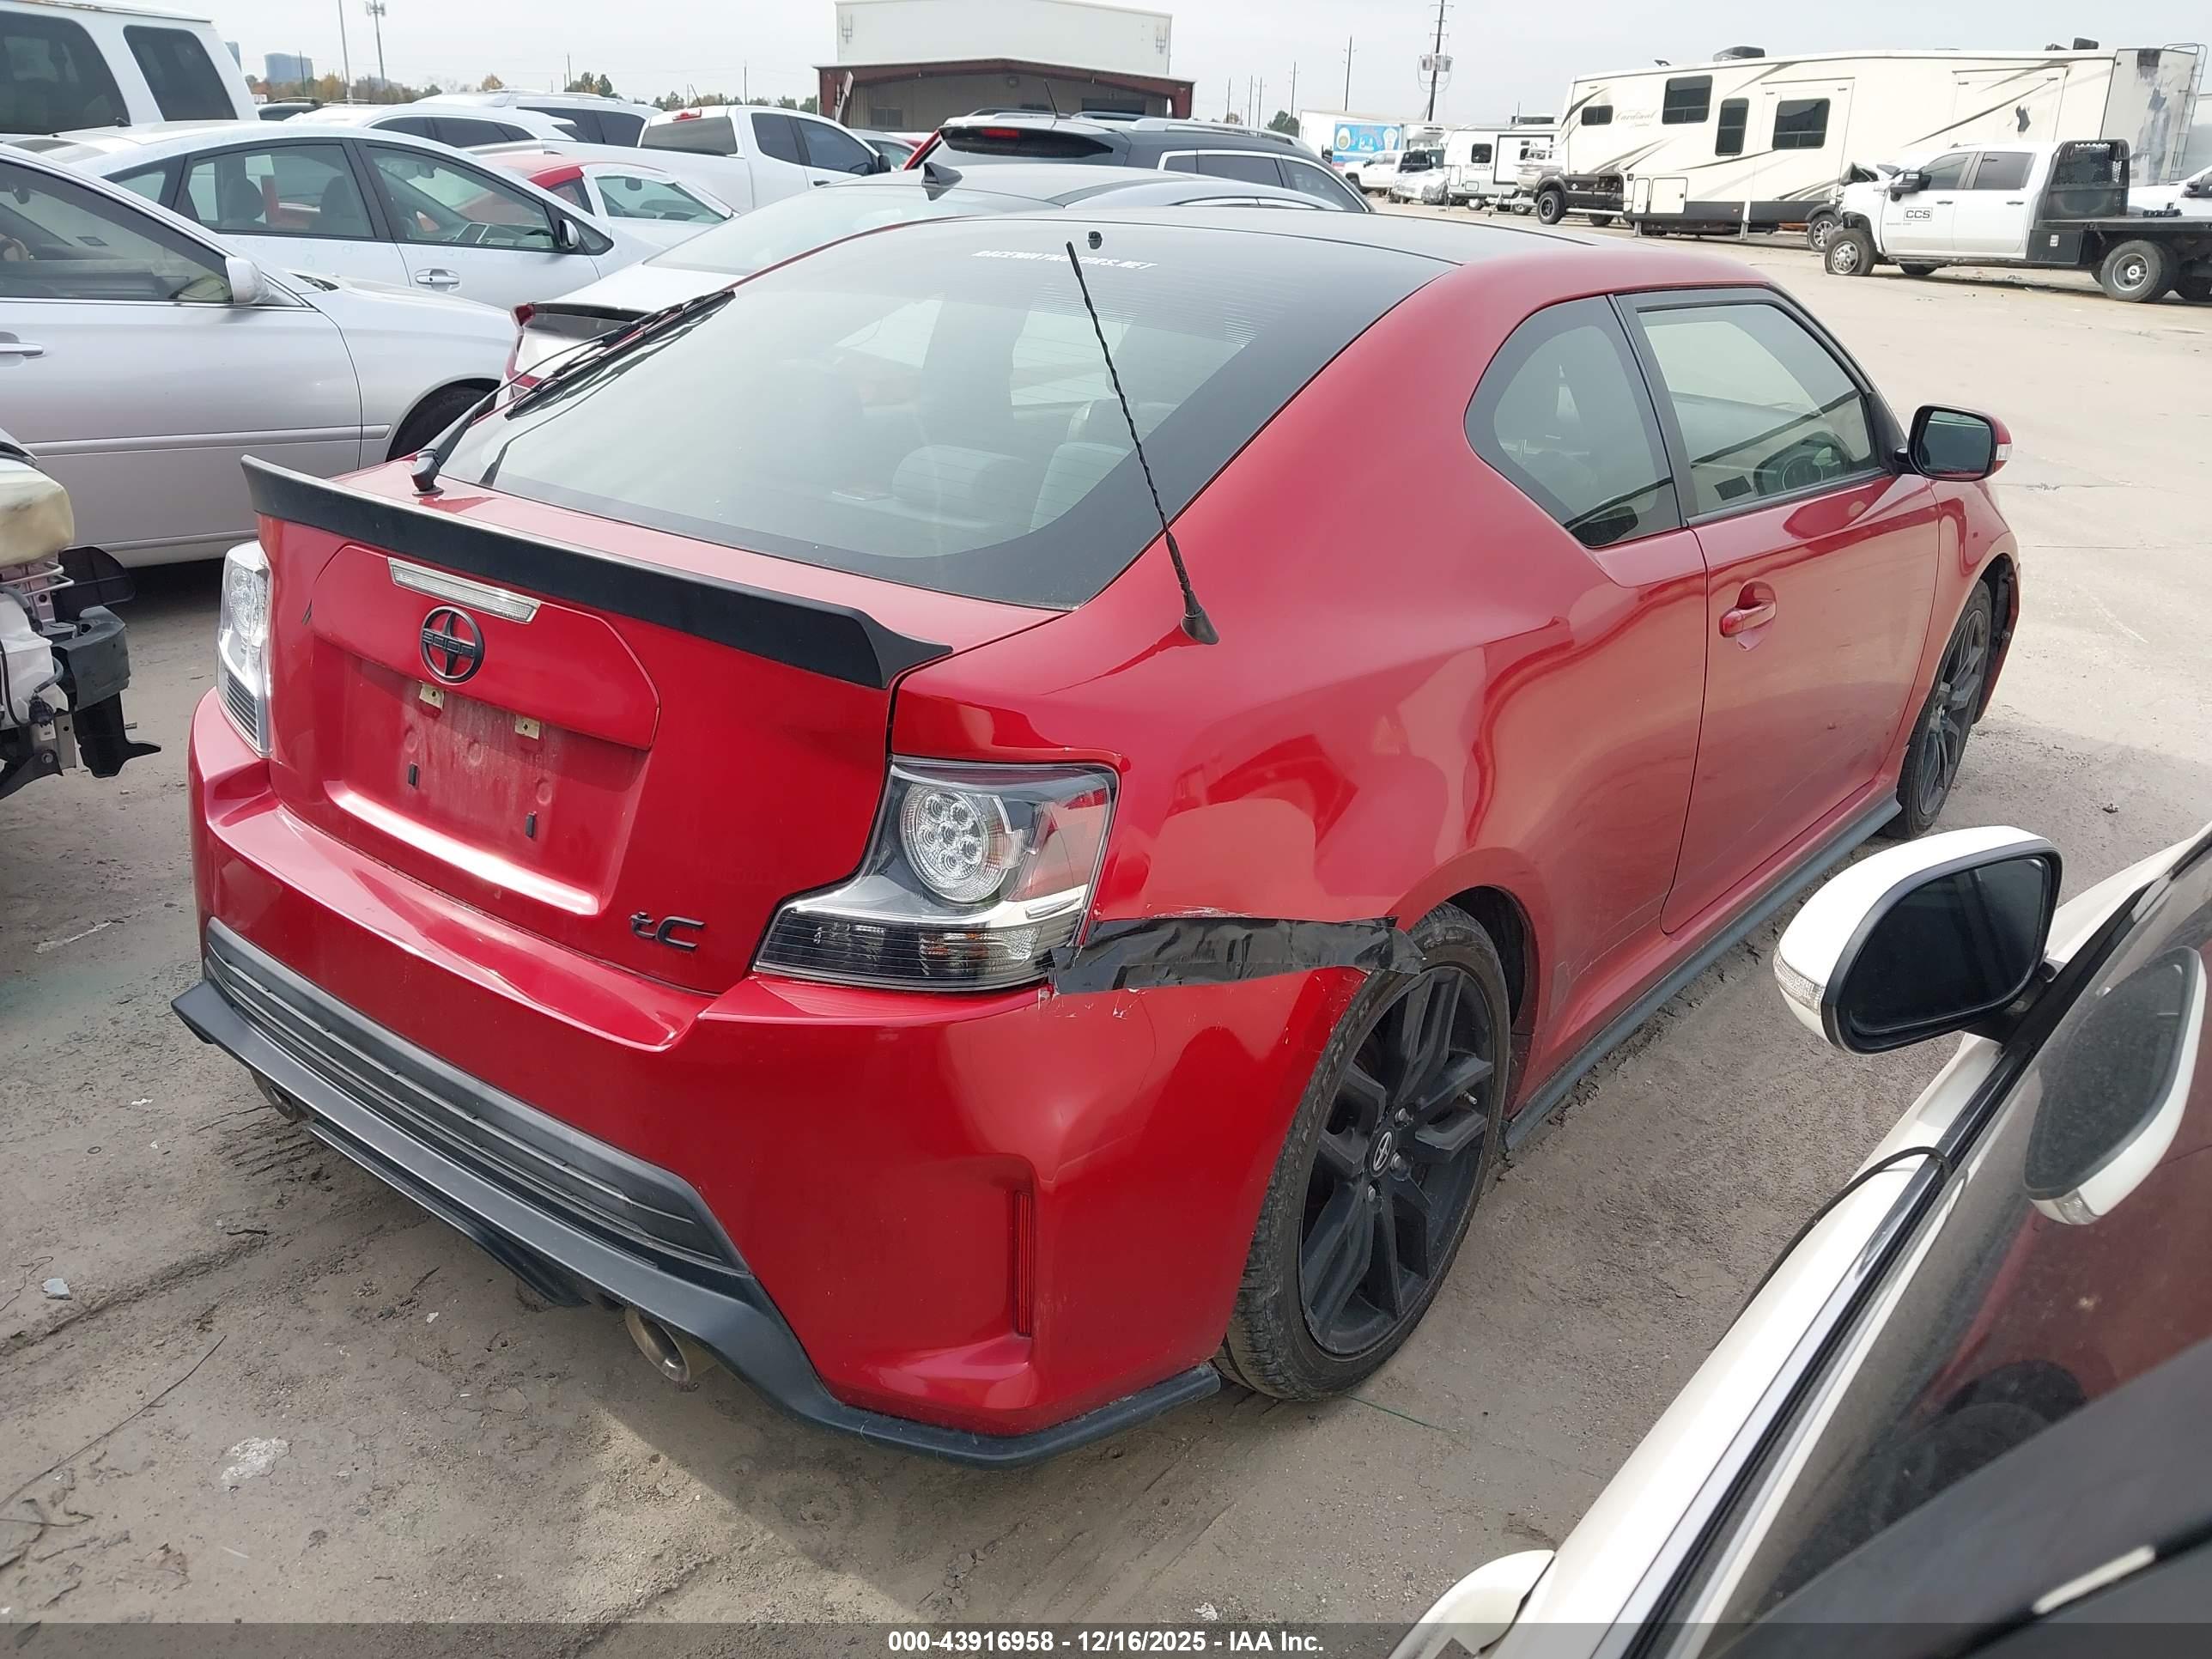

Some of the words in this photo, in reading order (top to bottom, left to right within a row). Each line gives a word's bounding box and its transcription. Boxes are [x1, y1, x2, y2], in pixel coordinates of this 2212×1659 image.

[1905, 210, 1930, 218] CCS
[971, 250, 1158, 270] RACEWAYMOORS.NET
[422, 631, 475, 657] SCION
[629, 912, 706, 951] tC
